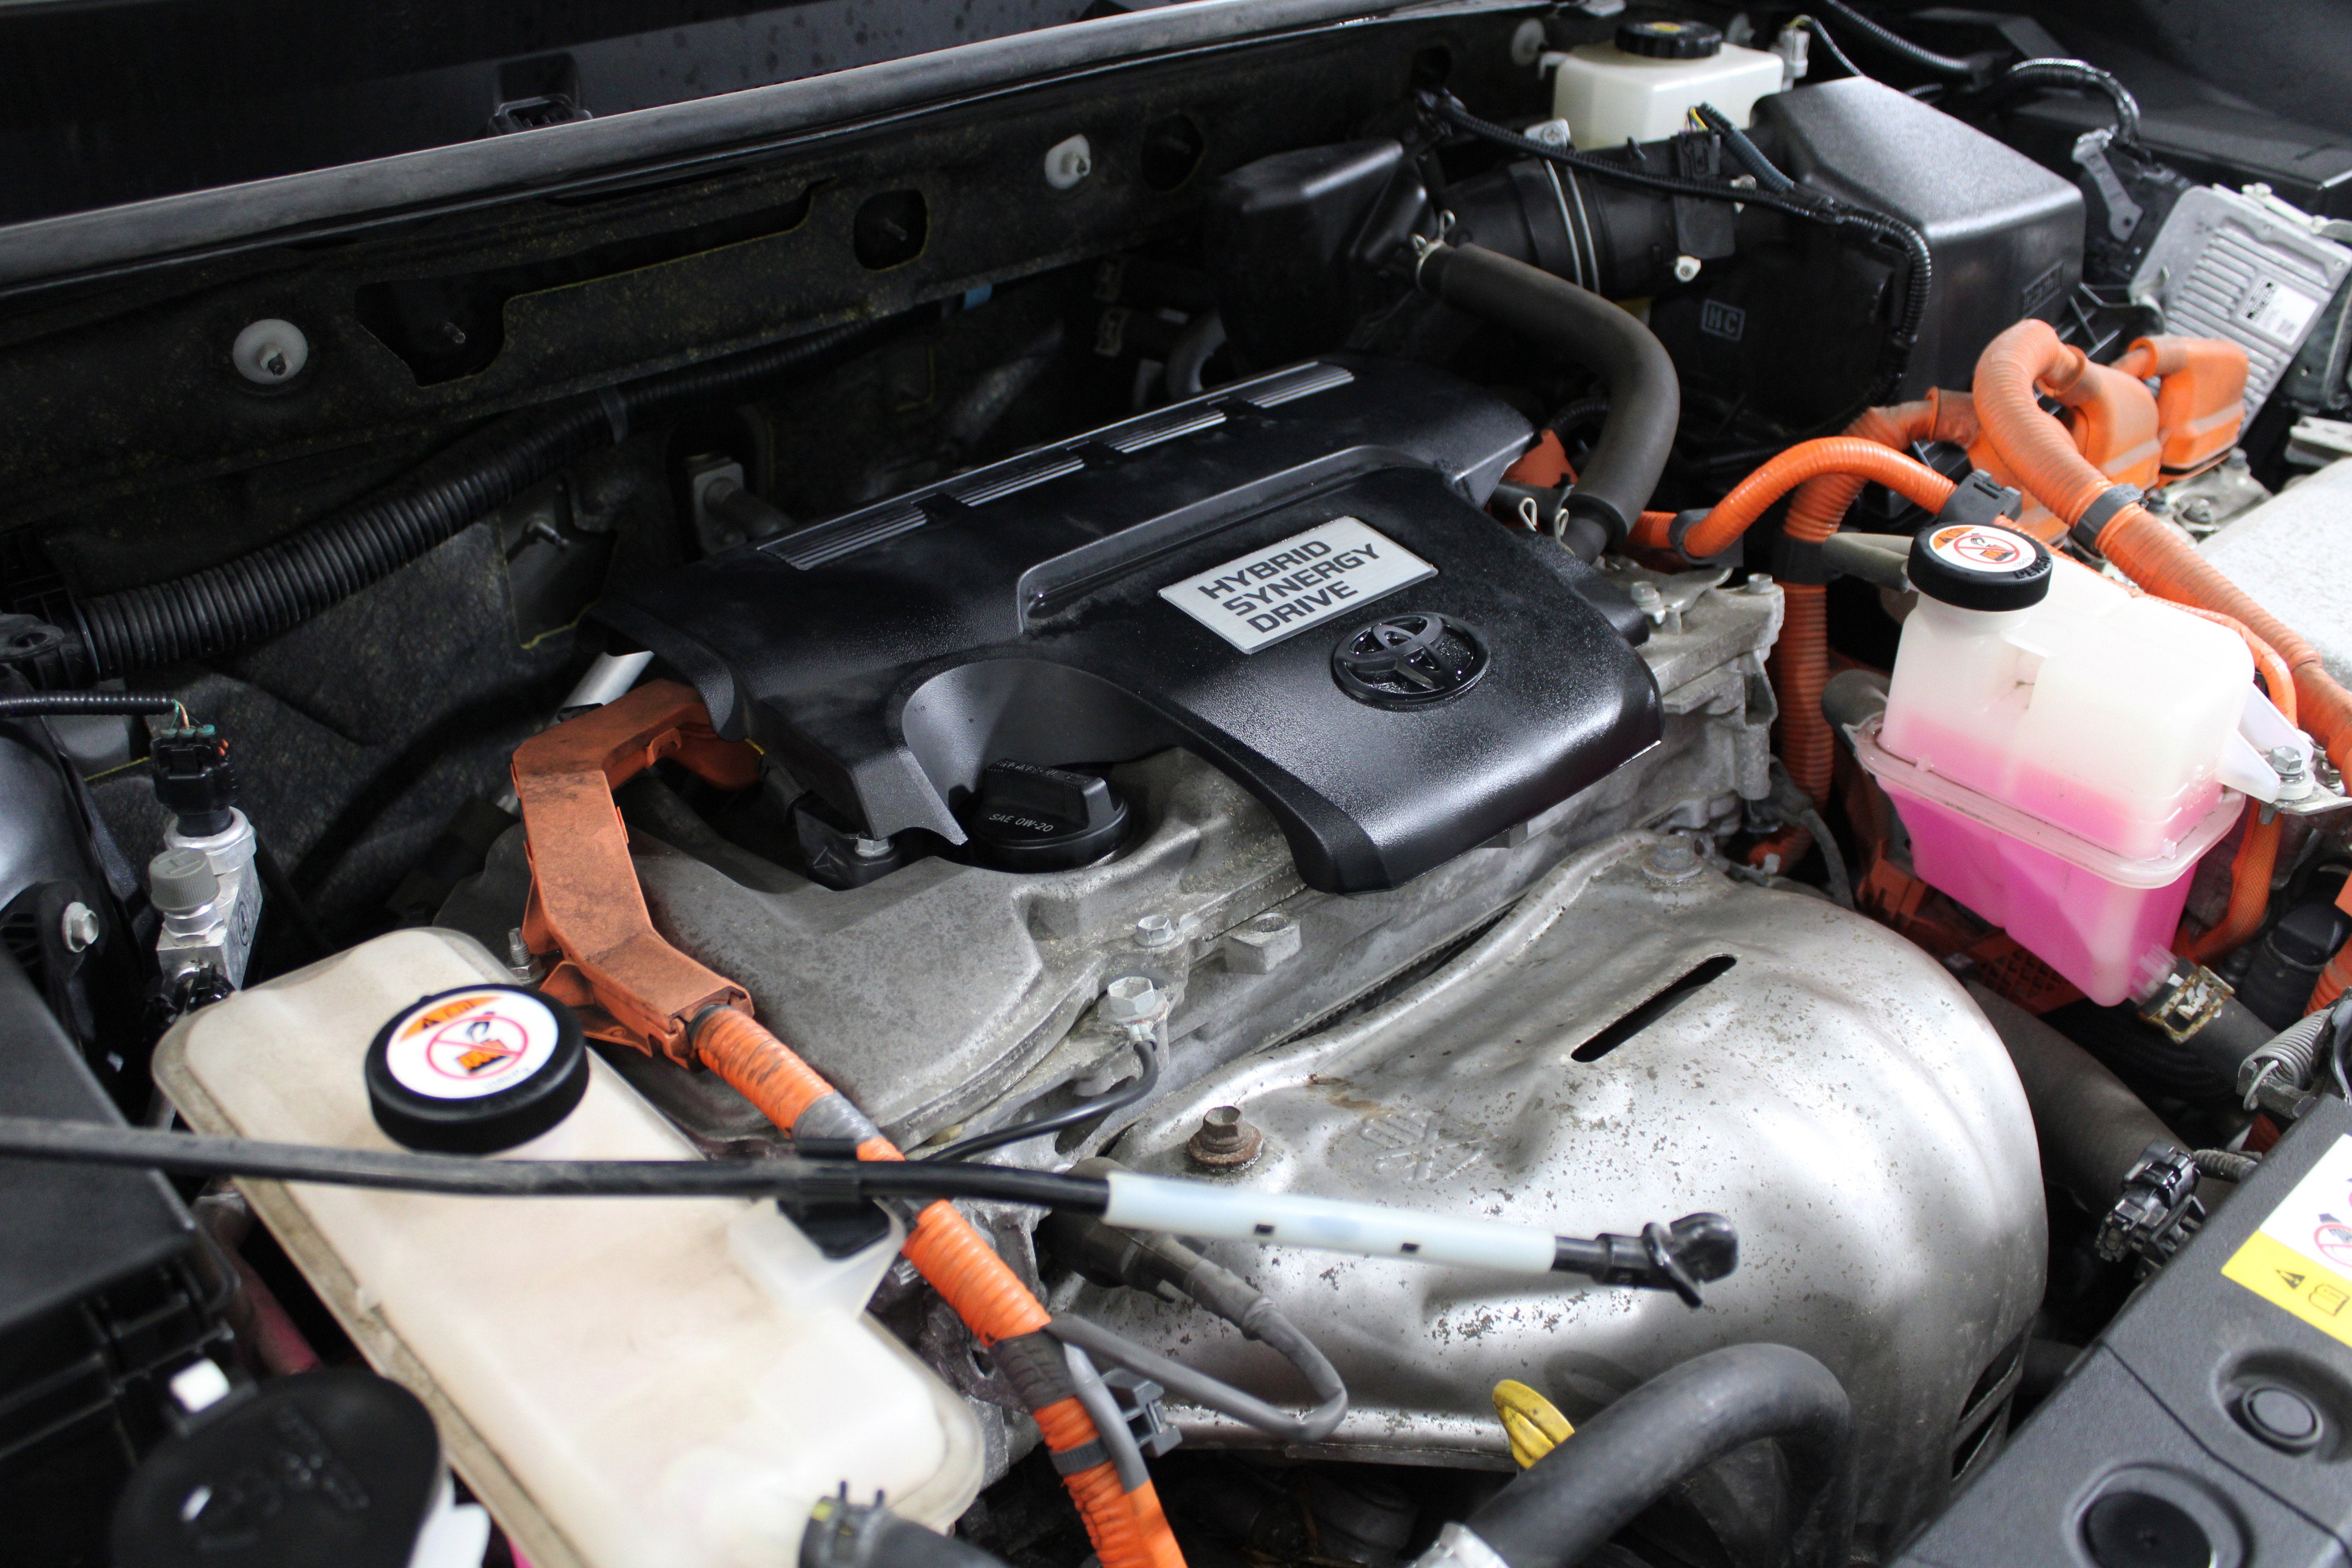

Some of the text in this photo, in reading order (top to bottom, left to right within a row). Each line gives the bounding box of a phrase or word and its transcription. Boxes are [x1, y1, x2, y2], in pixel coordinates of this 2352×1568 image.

[1198, 541, 1332, 600] HYBRID
[1223, 543, 1380, 616] SYNERGY
[1246, 580, 1359, 633] DRIVE
[989, 814, 1054, 832] SAE 0W-20
